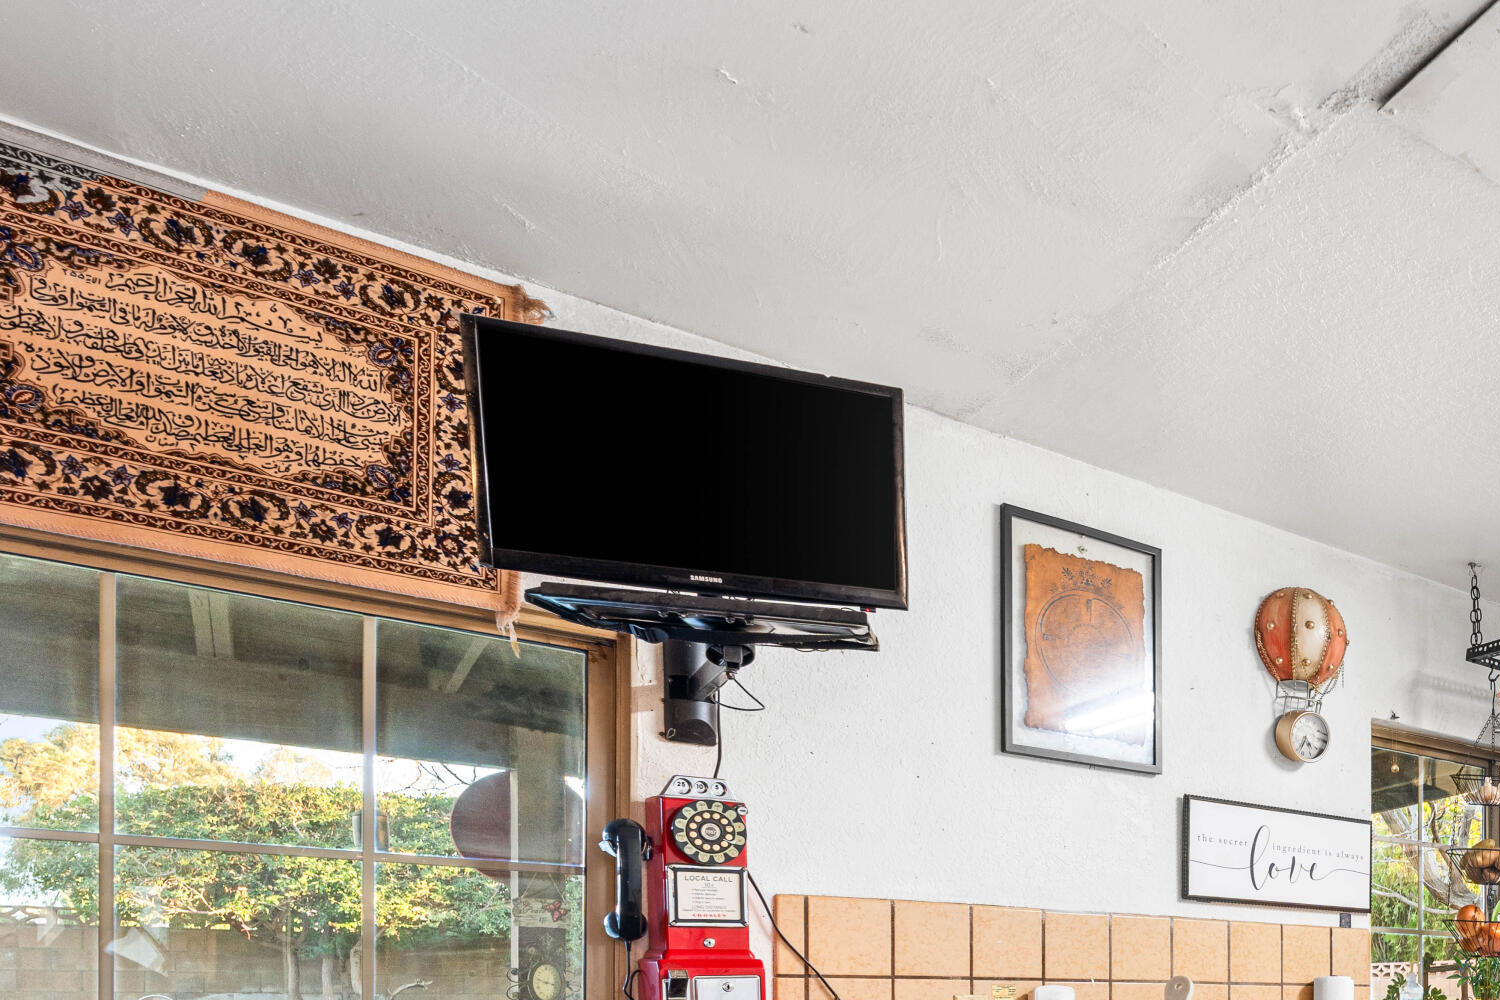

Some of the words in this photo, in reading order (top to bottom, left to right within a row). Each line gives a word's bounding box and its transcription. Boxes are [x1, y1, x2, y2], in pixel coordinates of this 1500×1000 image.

[690, 574, 723, 584] SAMSUNG
[1197, 834, 1214, 843] the
[1218, 838, 1249, 847] secret
[1272, 843, 1321, 857] ingredient
[1324, 849, 1333, 857] is
[1336, 851, 1365, 862] always
[1250, 825, 1326, 890] love
